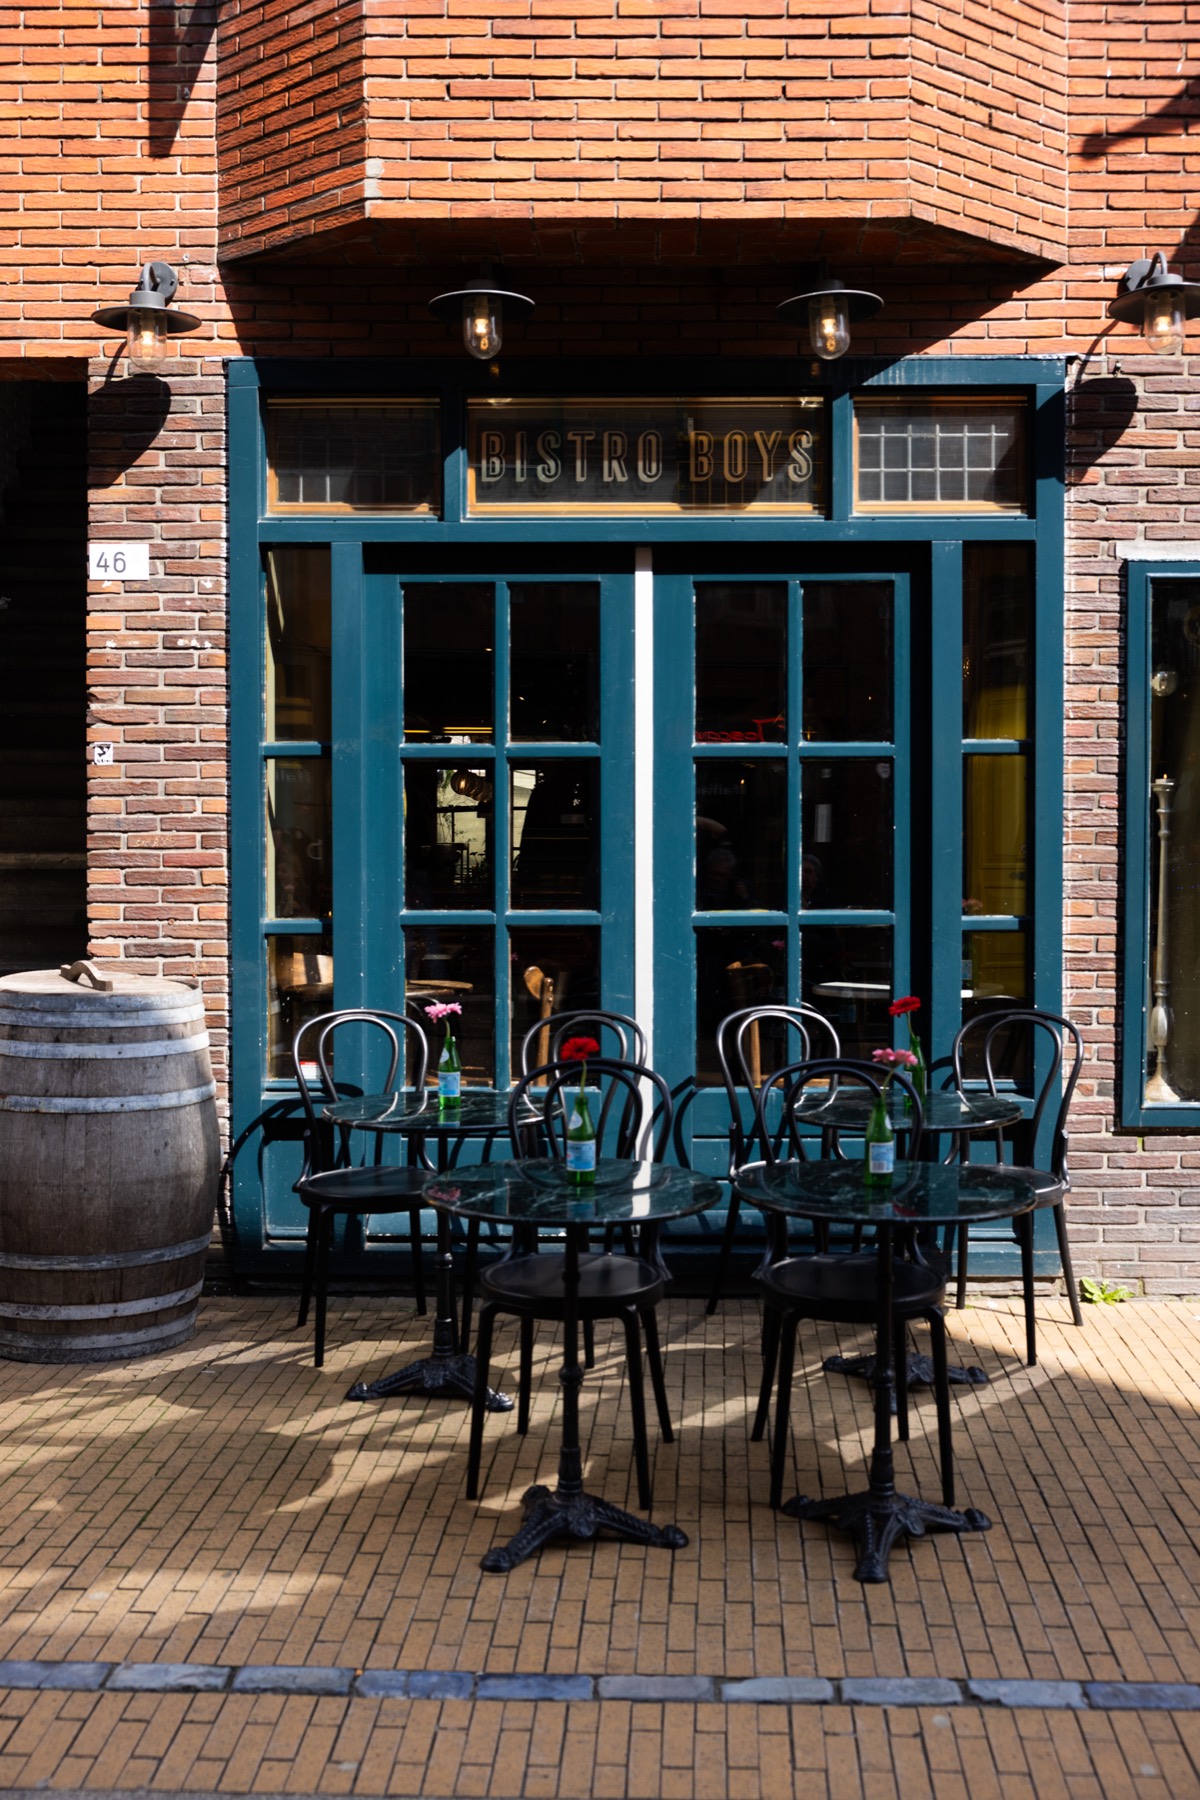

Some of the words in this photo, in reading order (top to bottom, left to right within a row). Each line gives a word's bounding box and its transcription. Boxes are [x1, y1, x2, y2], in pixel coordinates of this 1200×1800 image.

[481, 430, 662, 483] BISTRO
[689, 430, 814, 483] BOYS
[96, 551, 126, 573] 46
